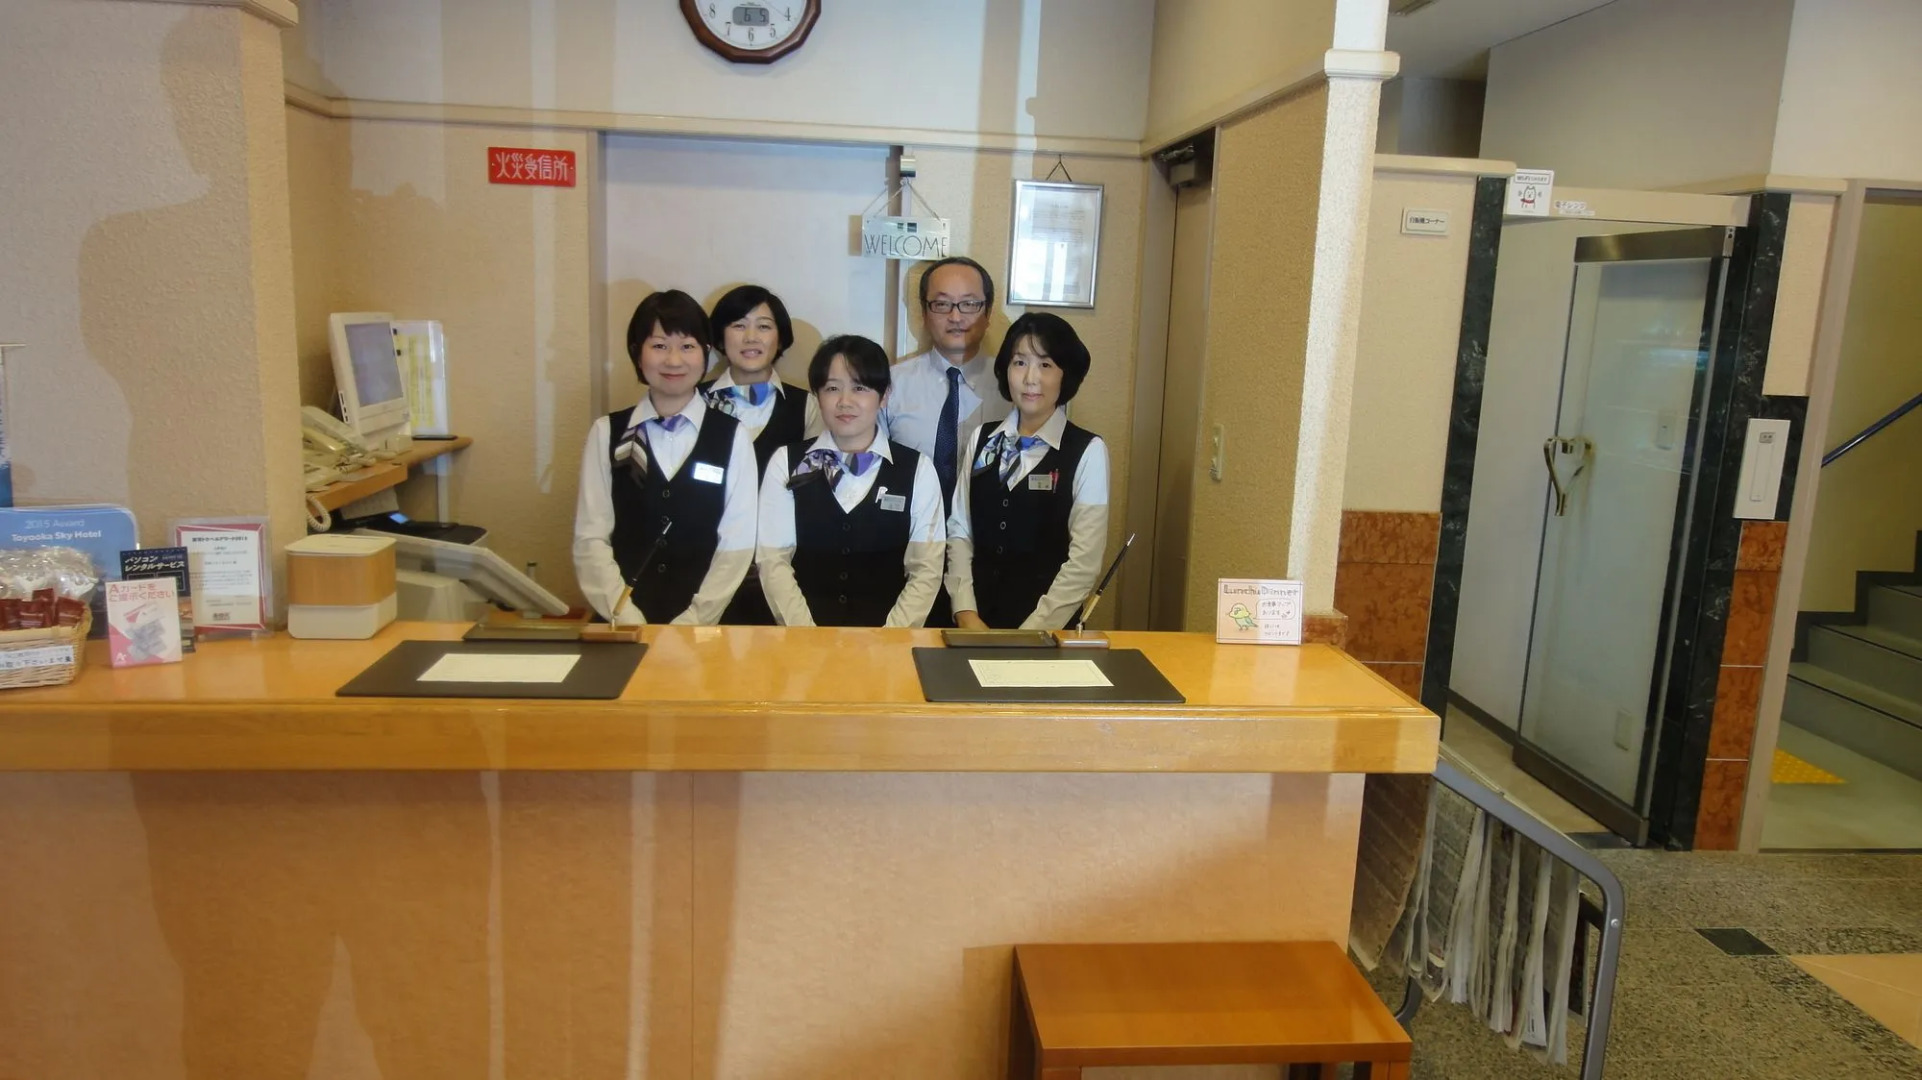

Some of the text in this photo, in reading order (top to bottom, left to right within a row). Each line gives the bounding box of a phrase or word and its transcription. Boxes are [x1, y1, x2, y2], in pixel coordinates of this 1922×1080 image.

[710, 3, 716, 18] 8
[784, 7, 791, 21] 4
[725, 22, 732, 37] 7
[747, 27, 754, 42] 6
[770, 24, 777, 38] 5
[495, 151, 568, 182] 火災受信所
[864, 234, 948, 258] WELCOME
[53, 518, 85, 528] Award
[11, 530, 102, 543] Toyooka Sky Hotel
[124, 561, 186, 573] レンタルサービス
[125, 556, 158, 565] パソコン
